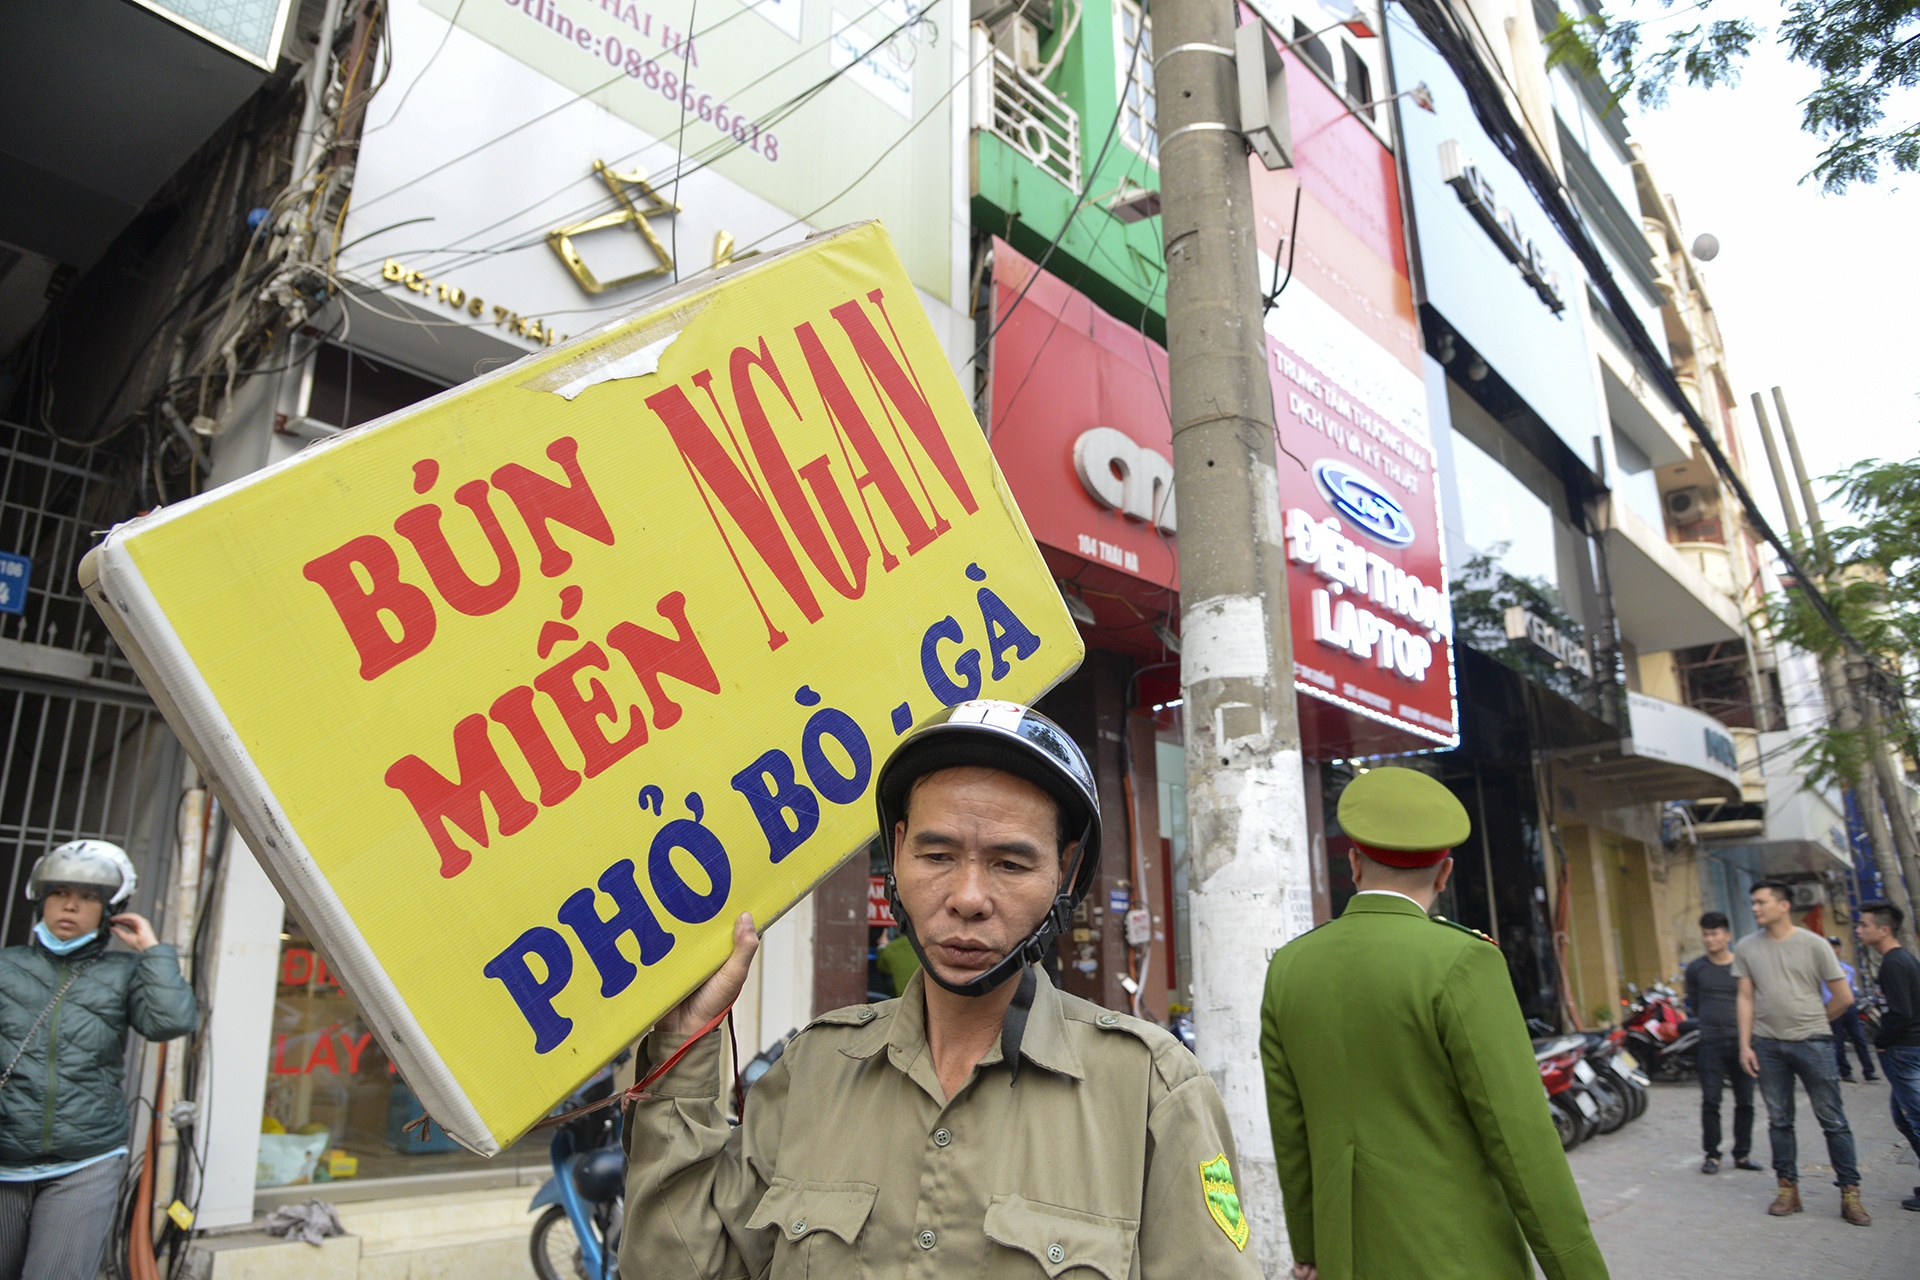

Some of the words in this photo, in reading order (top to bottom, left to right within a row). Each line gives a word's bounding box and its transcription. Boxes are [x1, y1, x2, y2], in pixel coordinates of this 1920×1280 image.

[645, 288, 979, 652] NGAN
[1273, 348, 1321, 401] TRUNG
[302, 436, 615, 681] BÚN
[1312, 588, 1433, 682] LAPTOP
[384, 585, 721, 879] MIẾN
[483, 784, 732, 1054] PHỞ
[731, 685, 872, 864] BÒ
[920, 563, 1041, 708] GÀ
[273, 1022, 372, 1075] LẤY
